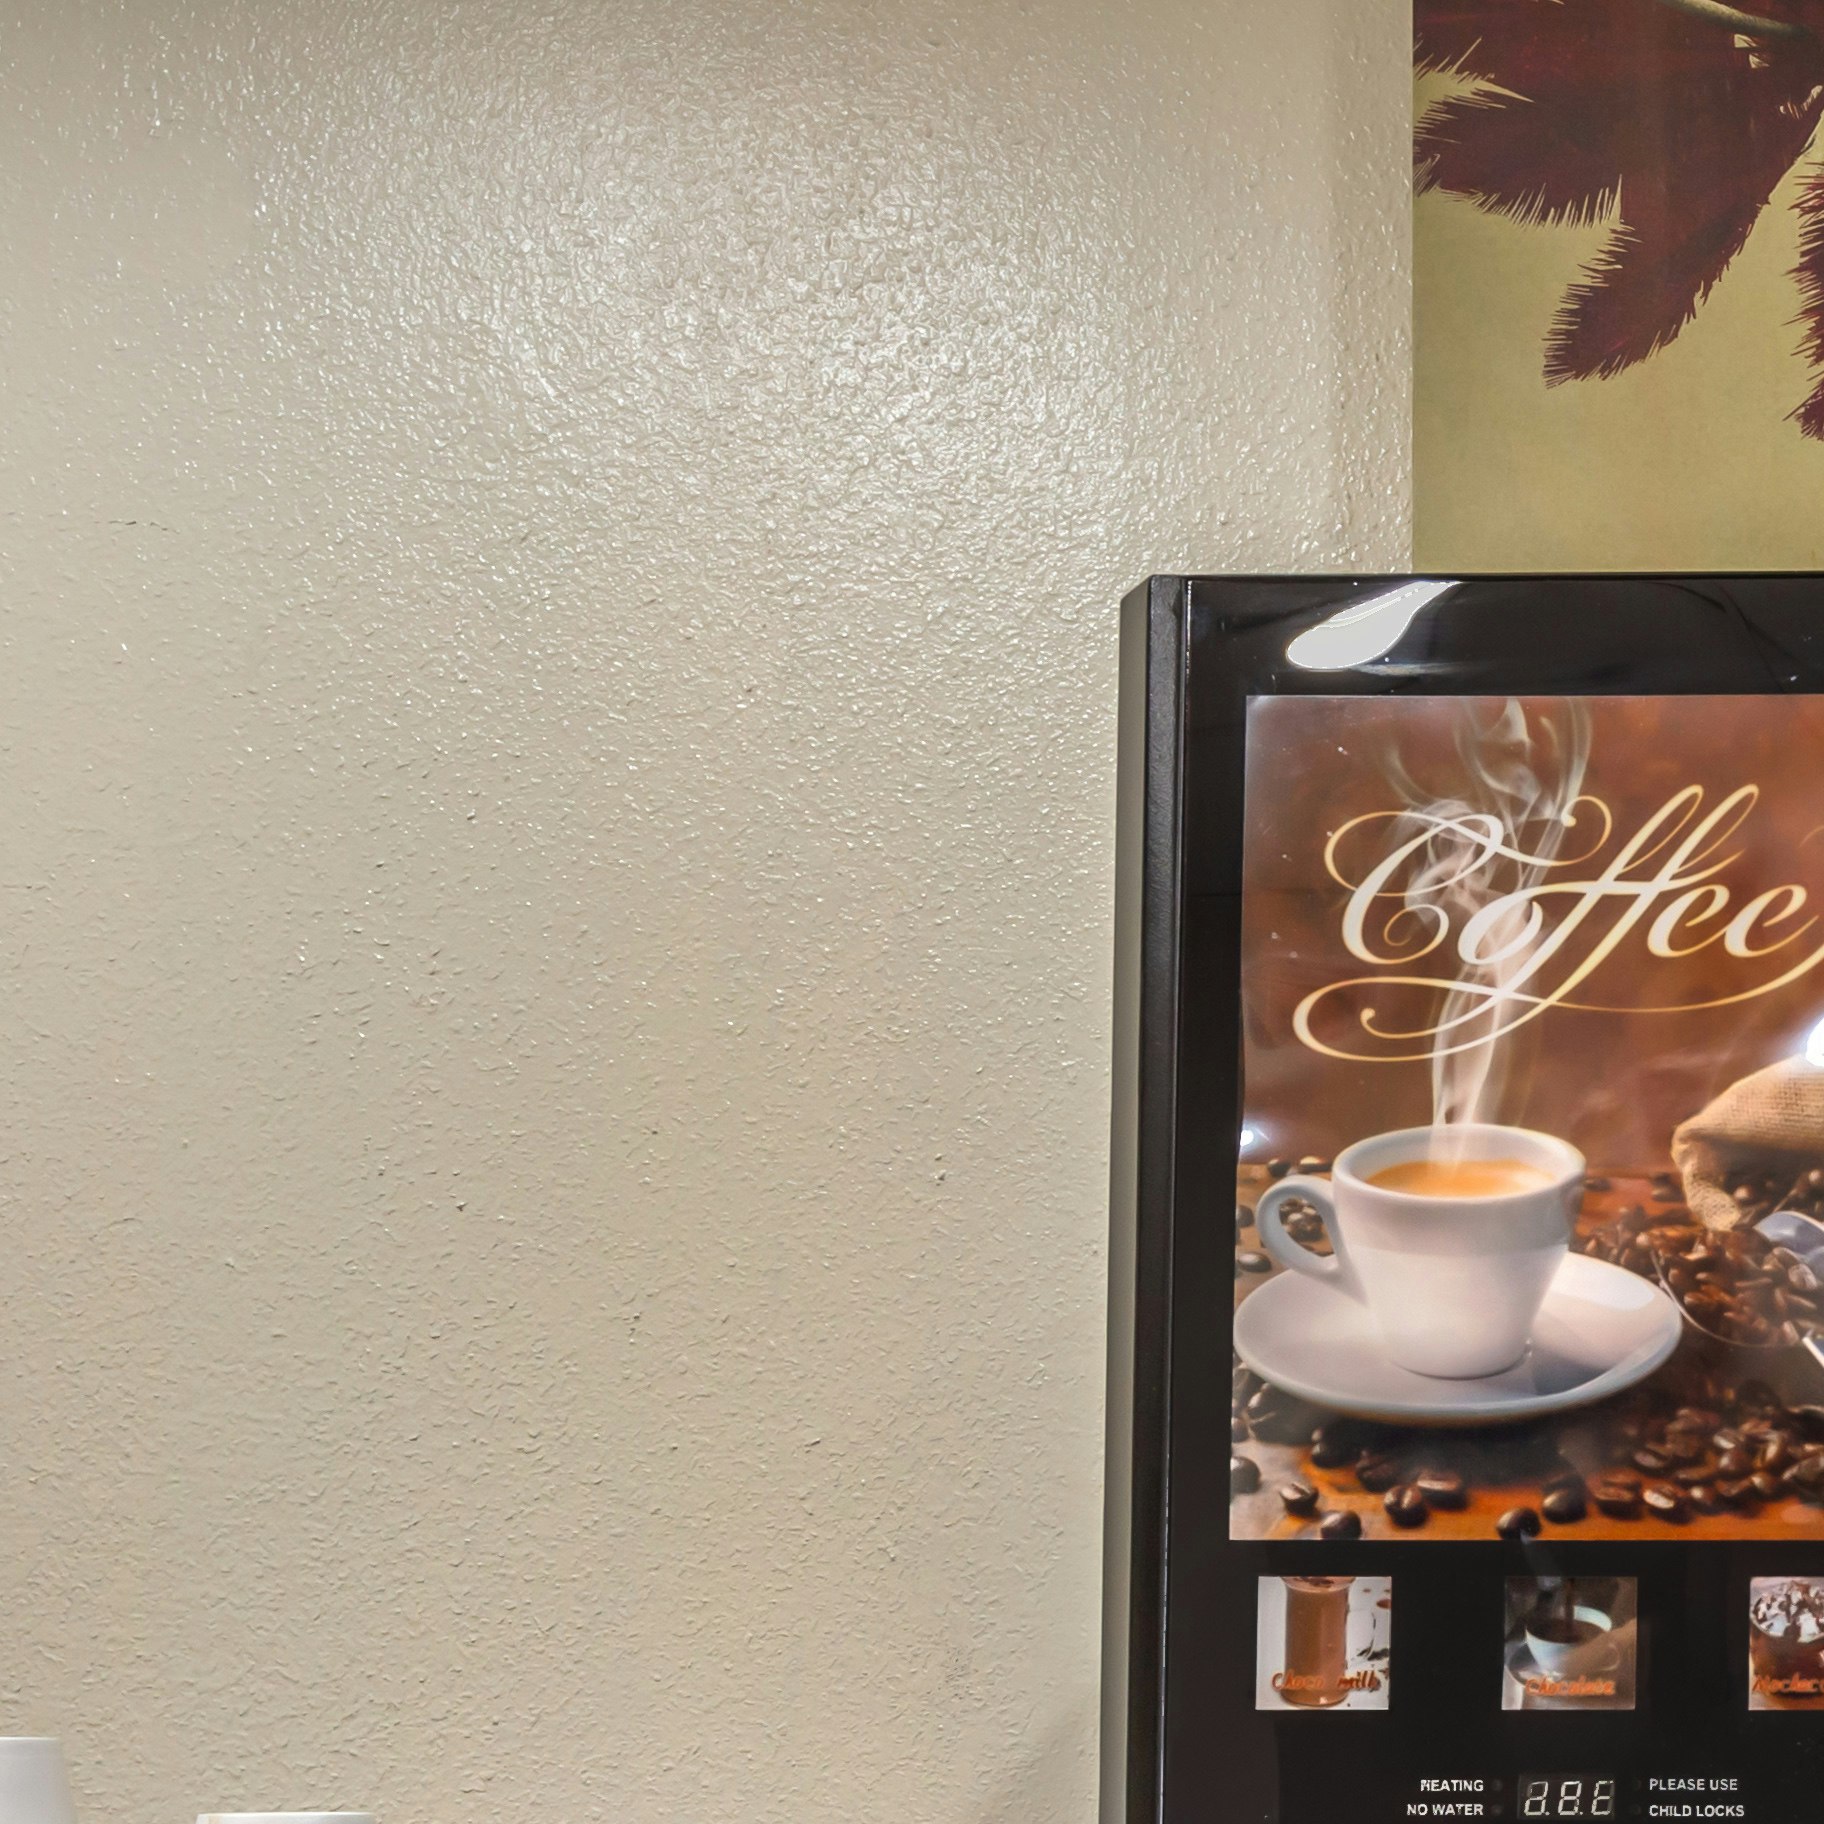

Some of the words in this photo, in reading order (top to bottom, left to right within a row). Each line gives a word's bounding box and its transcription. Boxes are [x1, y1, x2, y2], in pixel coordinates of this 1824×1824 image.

[1420, 1779, 1484, 1793] HEATING
[1649, 1778, 1705, 1791] PLEASE
[1709, 1778, 1739, 1791] USE
[1407, 1803, 1431, 1817] NO
[1432, 1803, 1484, 1817] WATER
[1649, 1804, 1692, 1817] CHILD
[1696, 1804, 1745, 1818] LOCKS
